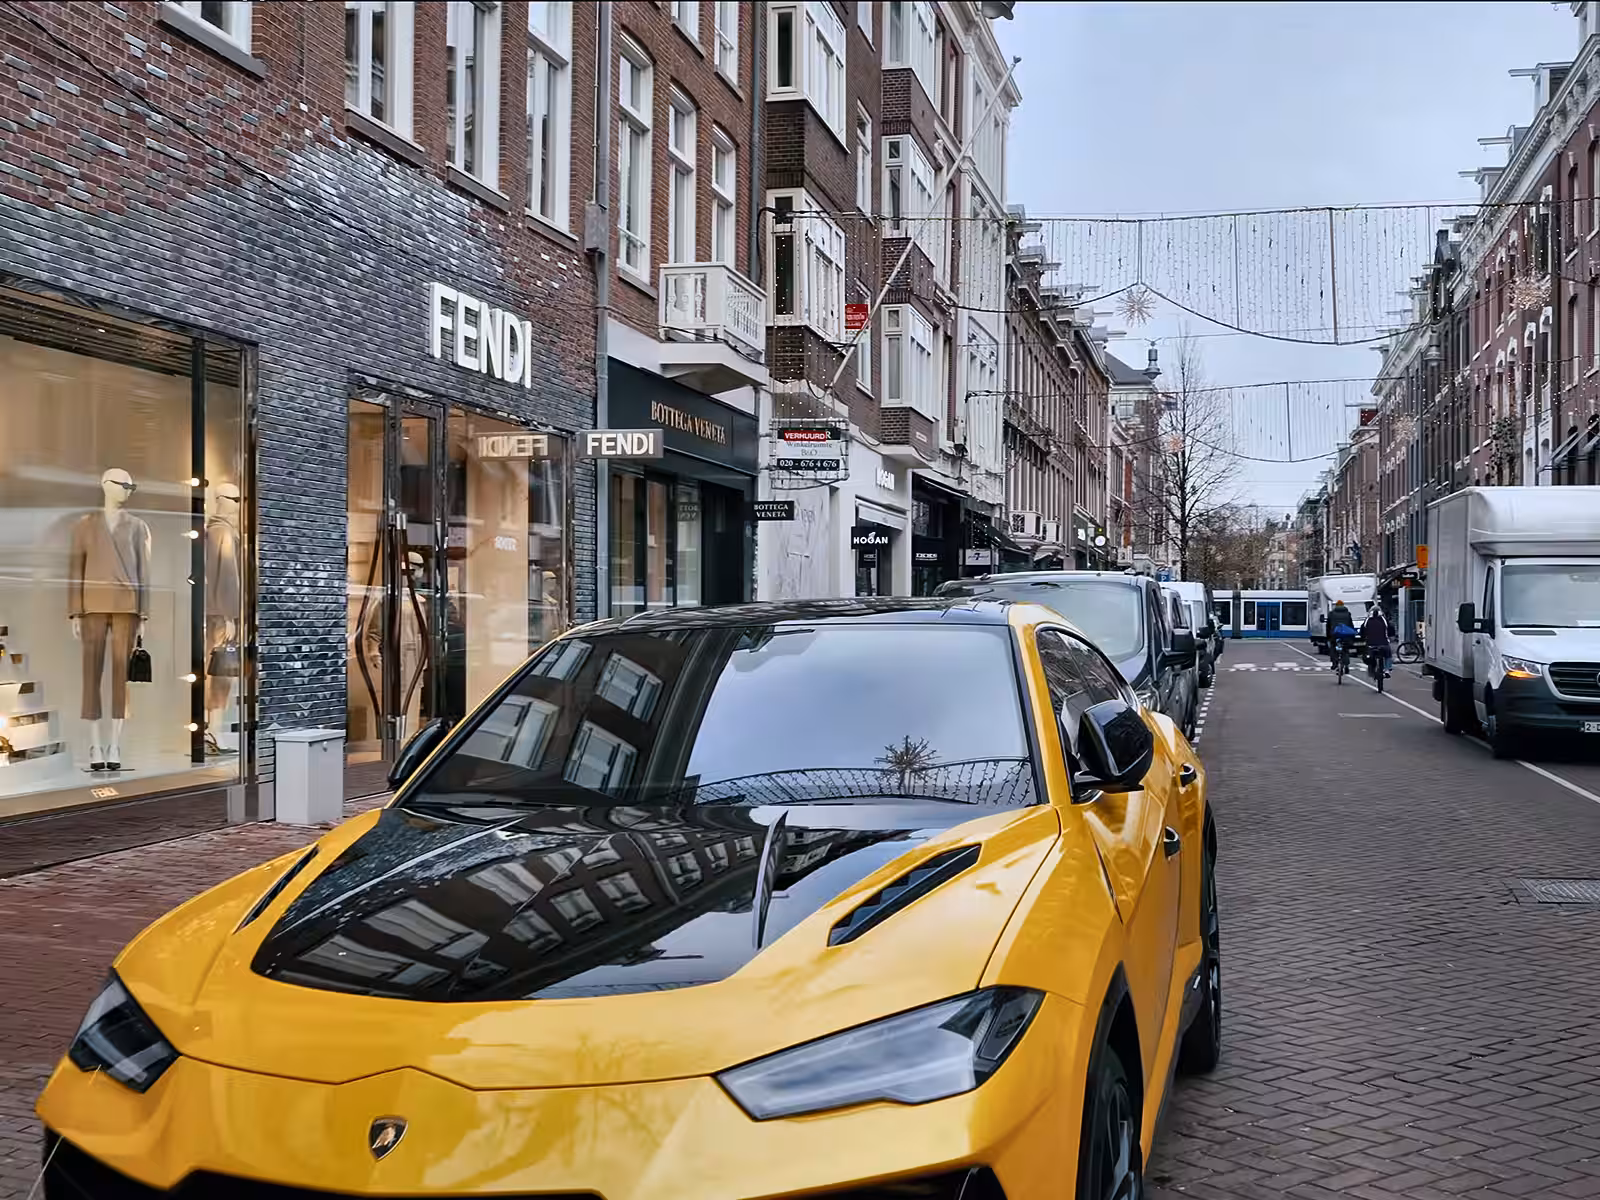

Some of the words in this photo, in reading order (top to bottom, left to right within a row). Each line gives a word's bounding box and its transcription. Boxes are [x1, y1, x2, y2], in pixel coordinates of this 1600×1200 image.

[429, 282, 532, 389] FENDI
[651, 400, 693, 433] BOTTEGA
[694, 416, 726, 445] VENETA
[587, 433, 654, 455] FENDI
[853, 536, 888, 544] HOGAN
